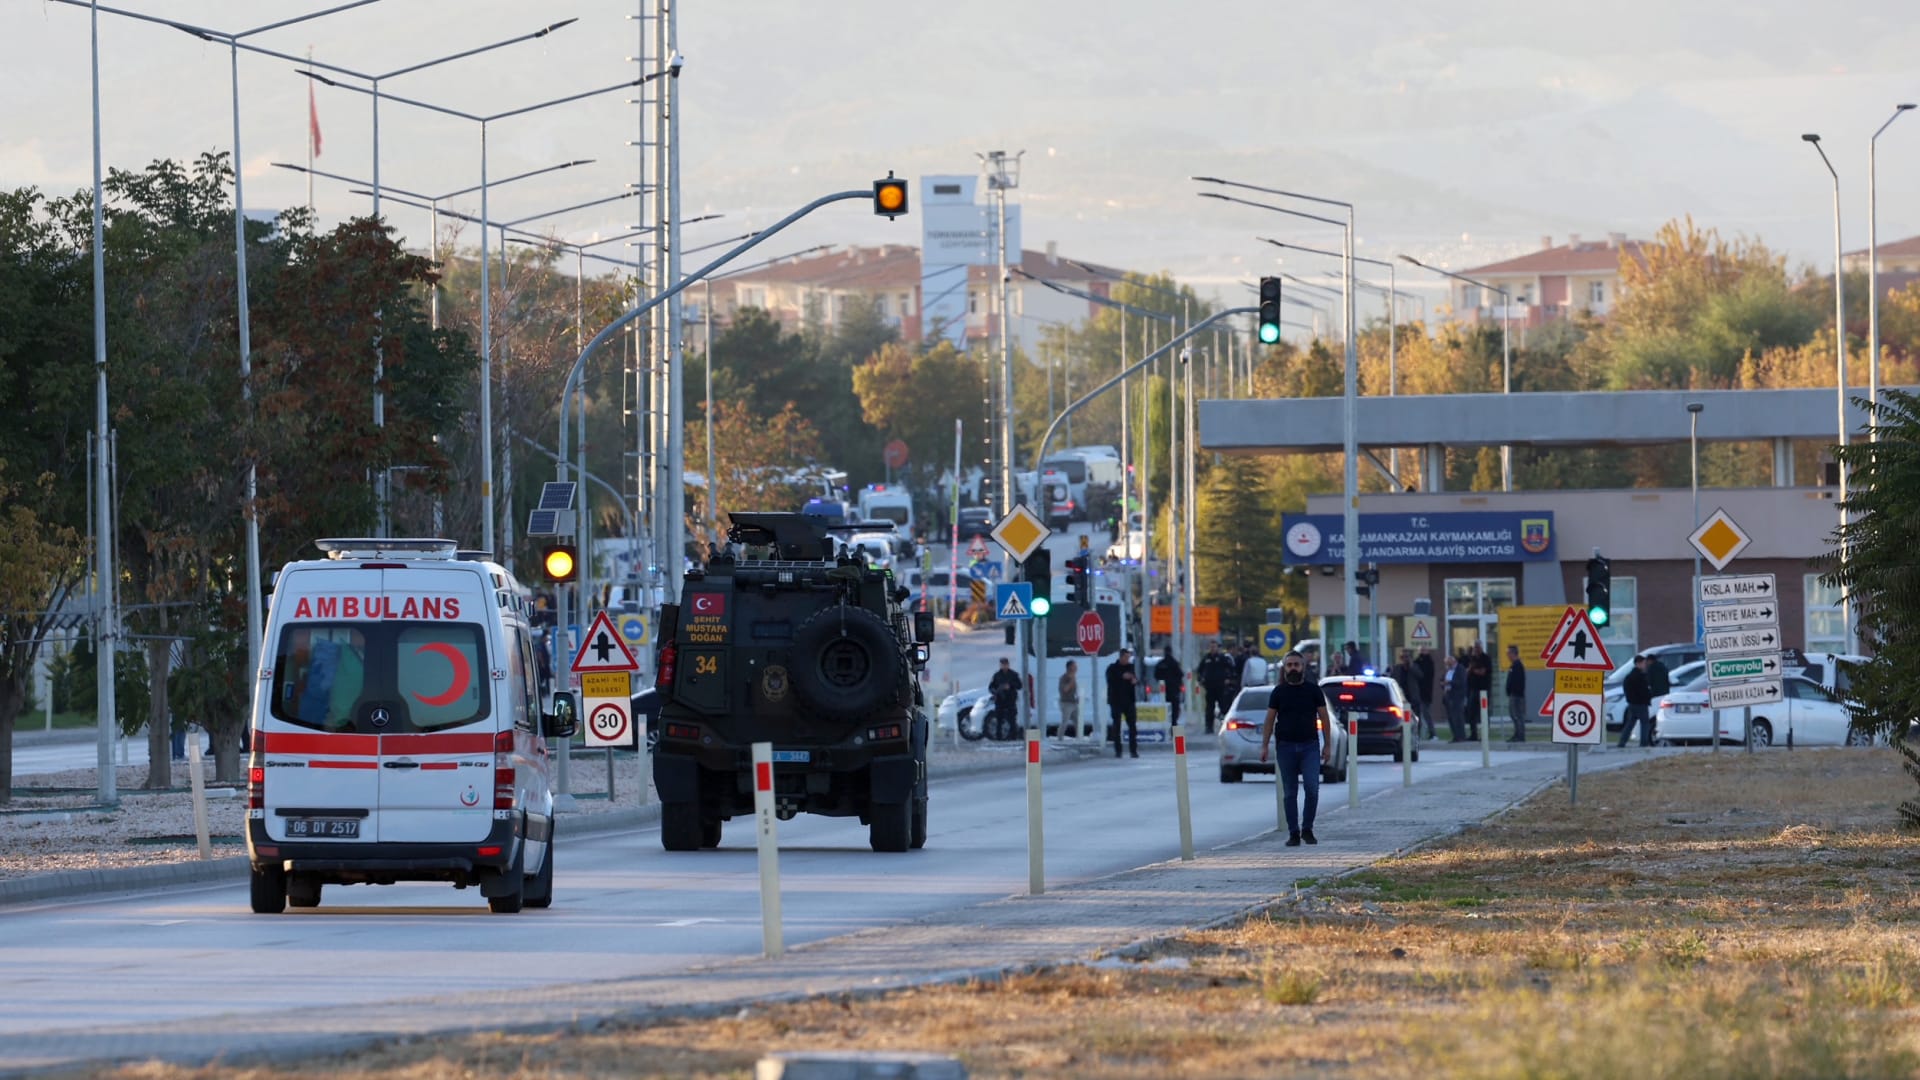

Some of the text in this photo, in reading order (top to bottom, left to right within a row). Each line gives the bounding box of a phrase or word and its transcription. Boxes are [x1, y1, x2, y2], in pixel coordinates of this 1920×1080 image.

[1411, 518, 1430, 528] T.C.
[1329, 529, 1512, 544] KAAMANKAZAN KAYMAKAMLIĞI
[1365, 546, 1426, 557] JANDARMA
[1467, 545, 1515, 556] NOKTASI
[1704, 582, 1757, 596] KIŞLA MAH.
[294, 597, 460, 619] AMBULANS
[686, 624, 728, 633] MUSTAFA
[1079, 625, 1101, 642] DUR
[690, 632, 723, 642] DOĞAN
[1741, 632, 1761, 647] ÜSSÜ
[695, 655, 717, 674] 34
[1712, 660, 1762, 676] Çevreyolu
[597, 713, 618, 728] 30
[1567, 711, 1588, 726] 30
[294, 821, 357, 834] 06 DY 2517
